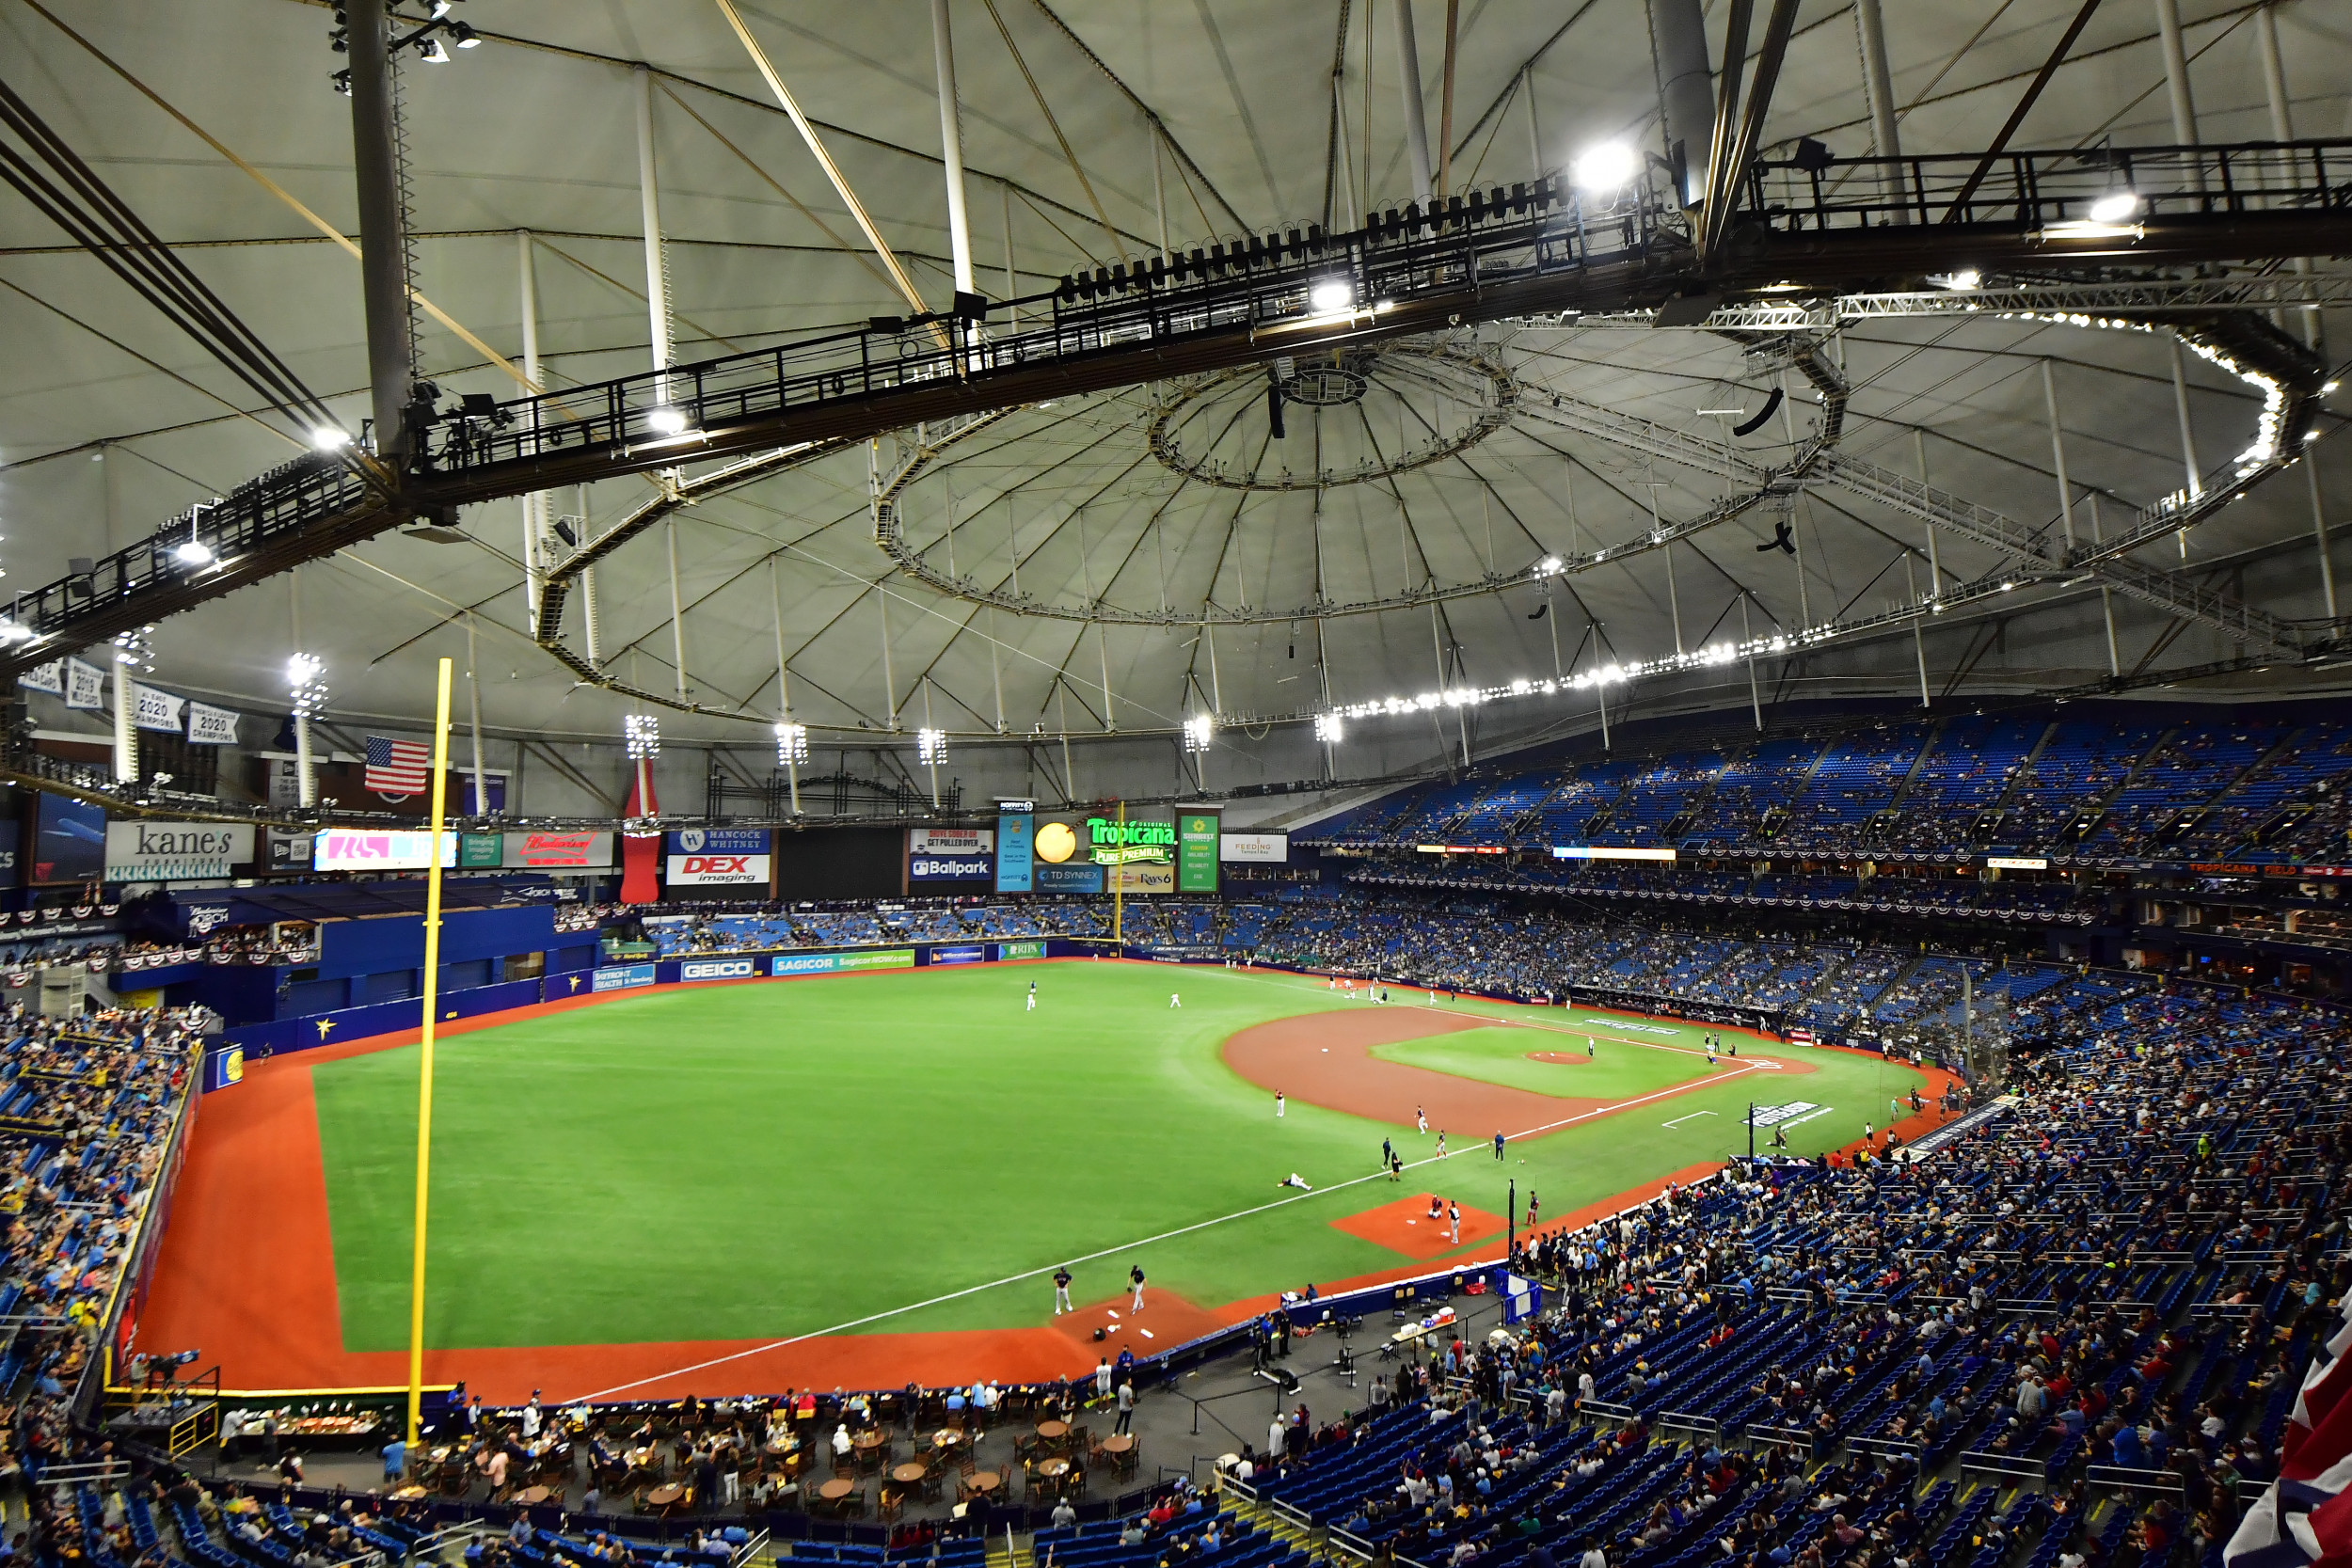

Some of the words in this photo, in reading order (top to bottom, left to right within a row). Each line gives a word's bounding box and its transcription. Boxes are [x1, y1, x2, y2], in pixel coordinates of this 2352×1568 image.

[139, 699, 167, 718] 2020
[135, 715, 174, 729] HAMPIONS
[200, 716, 227, 732] 2020
[193, 729, 232, 742] CHAMPIONS
[135, 824, 232, 855] kane's
[709, 831, 761, 839] HANCOCK
[1087, 817, 1175, 847] Tropicana
[709, 840, 761, 848] WHITNEY
[1096, 850, 1120, 863] PURE
[1121, 847, 1164, 861] PREMIUM
[682, 857, 751, 875] DEX
[930, 861, 988, 877] Ballpark
[2190, 863, 2258, 874] TROPICANA
[2264, 865, 2297, 876] FIELD
[698, 874, 755, 882] imaging
[1064, 871, 1099, 879] SYNNEX
[1163, 873, 1171, 883] 6
[684, 961, 752, 978] GEICO
[776, 958, 834, 971] SAGICOR
[839, 955, 911, 967] SagicorNOW.com
[1914, 1132, 1953, 1149] WELCOME
